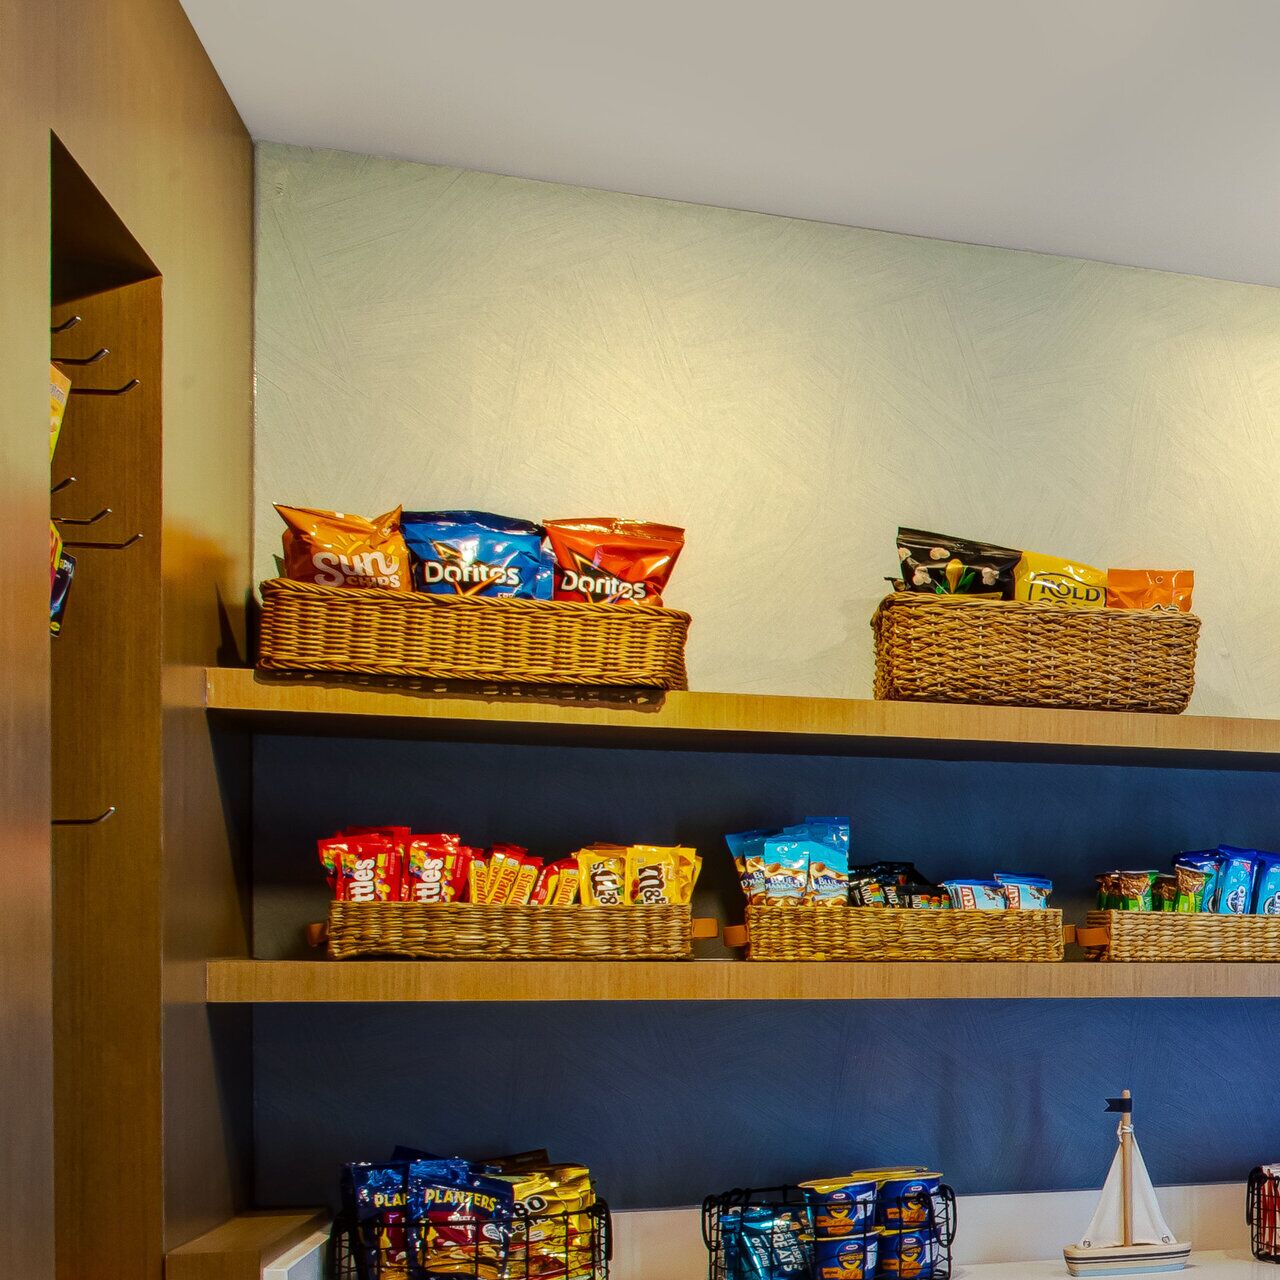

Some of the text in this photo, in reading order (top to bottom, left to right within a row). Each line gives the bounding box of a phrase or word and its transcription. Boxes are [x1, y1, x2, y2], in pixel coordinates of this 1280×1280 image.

[313, 550, 400, 588] Sun
[424, 560, 520, 587] Doritos
[560, 569, 646, 600] Doritos
[1040, 578, 1101, 602] ROLD
[424, 1188, 497, 1213] PLANTERS
